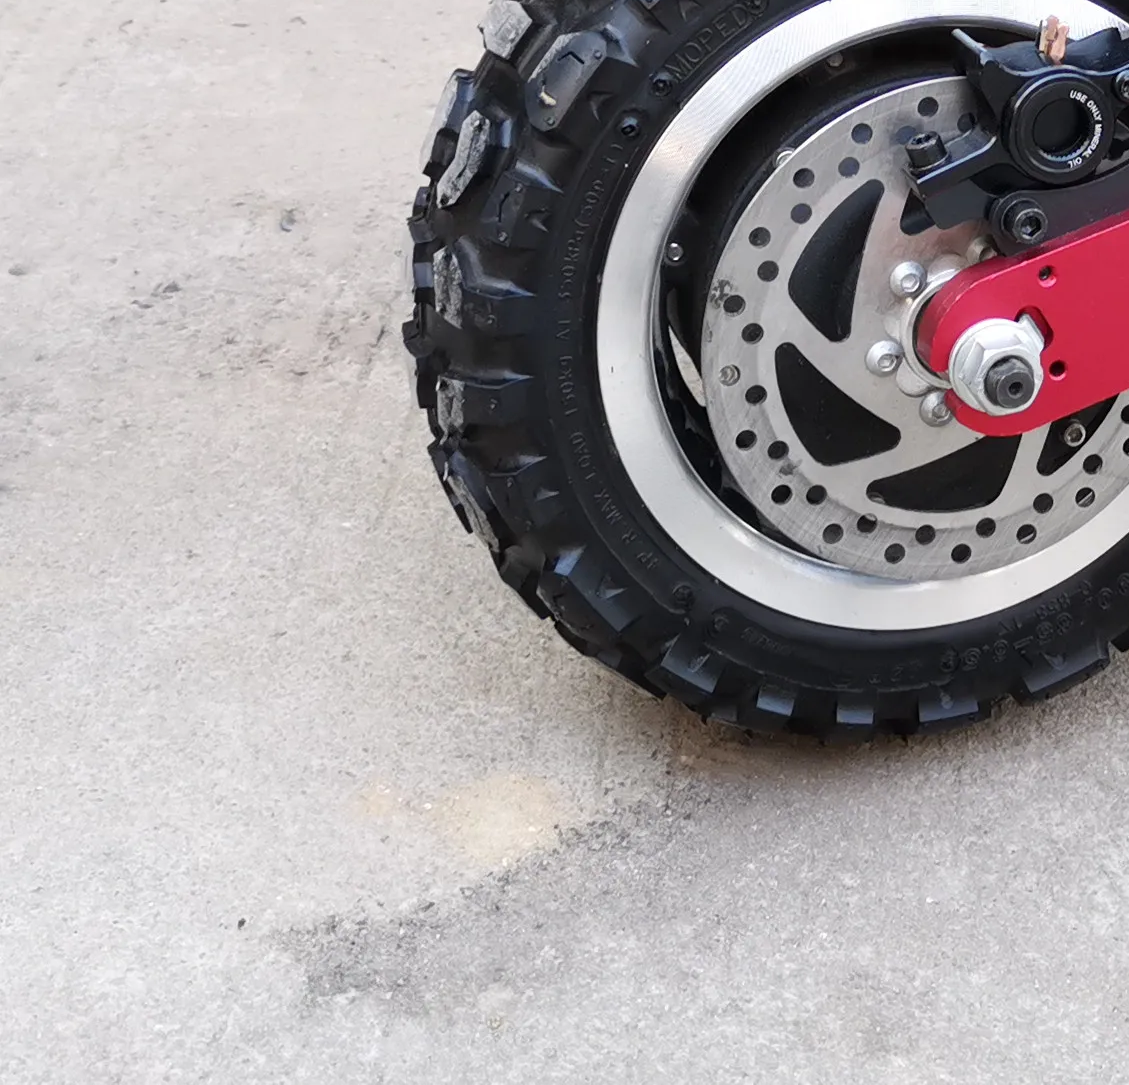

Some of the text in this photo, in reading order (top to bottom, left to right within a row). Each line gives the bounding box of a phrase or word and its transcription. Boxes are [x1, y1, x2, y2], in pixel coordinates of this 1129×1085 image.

[665, 2, 755, 81] MOPED
[1067, 90, 1103, 168] USE ONLY MINERAL OIL
